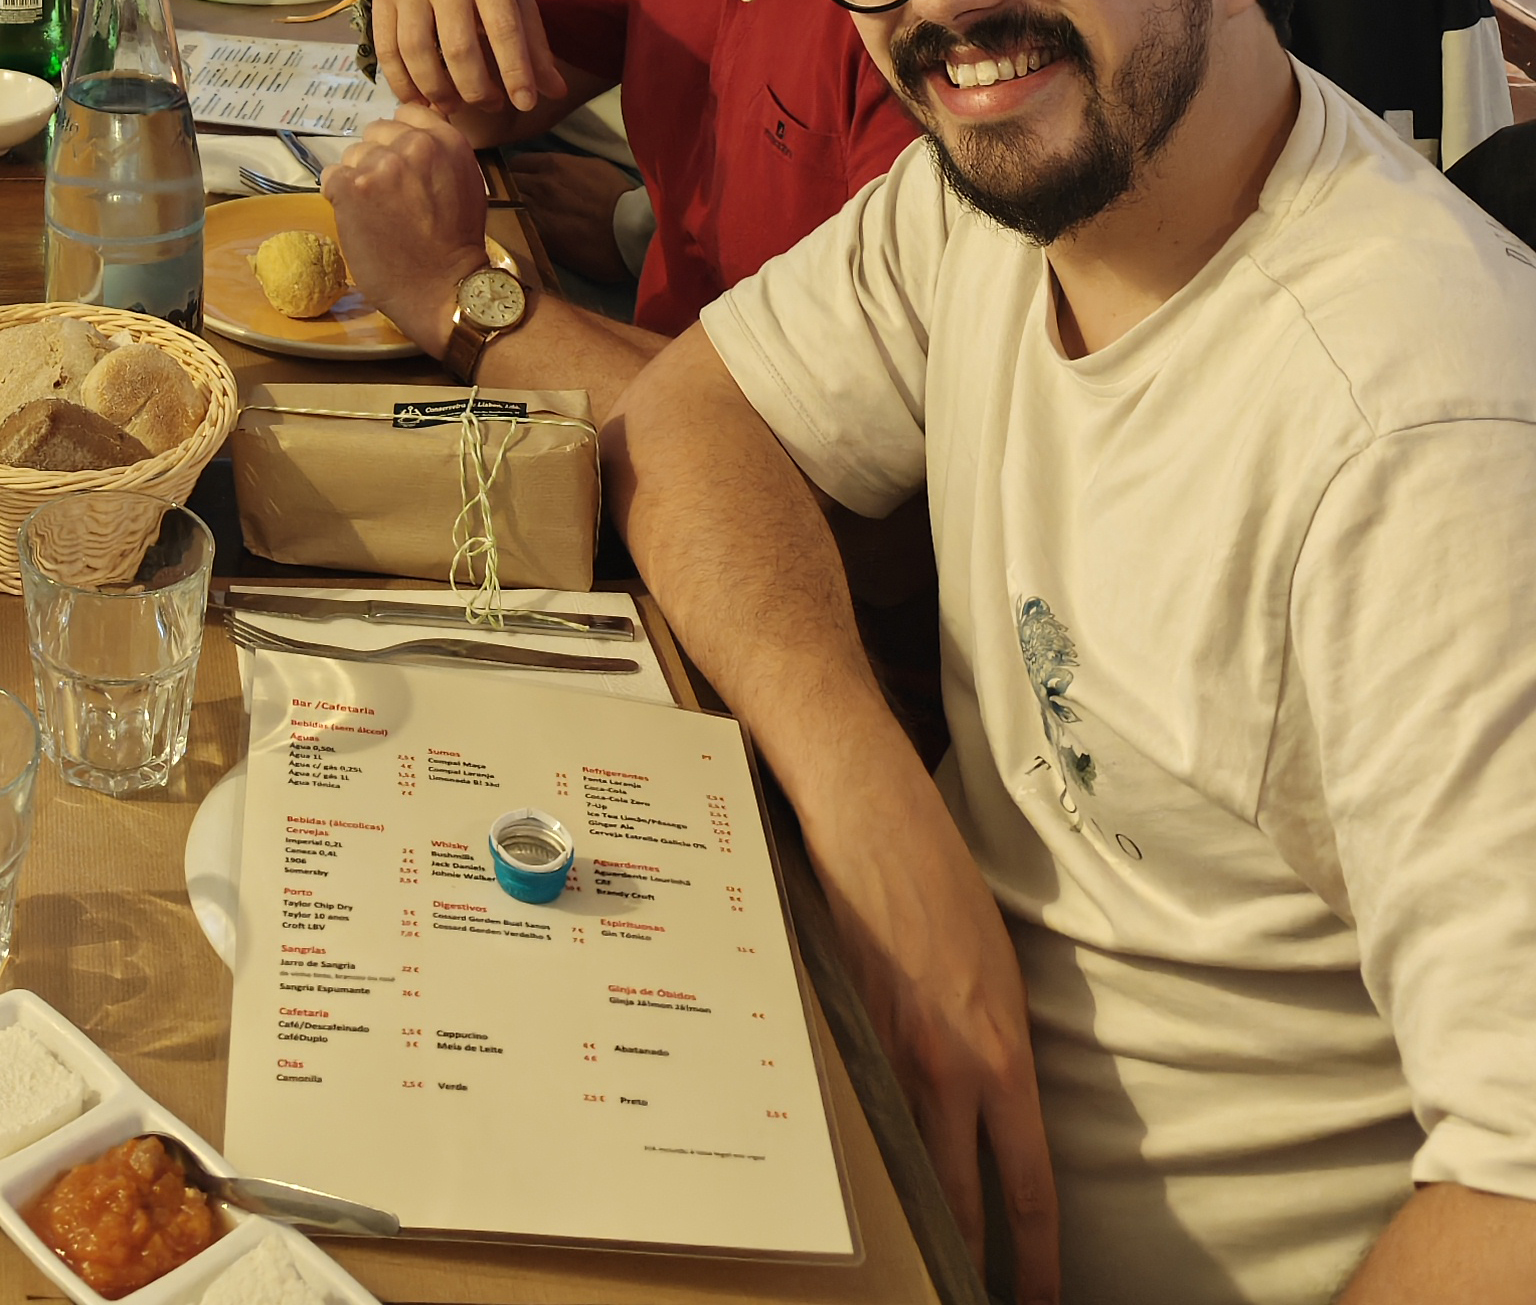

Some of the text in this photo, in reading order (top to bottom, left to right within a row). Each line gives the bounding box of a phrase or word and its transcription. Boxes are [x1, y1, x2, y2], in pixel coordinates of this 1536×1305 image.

[292, 699, 312, 708] Bar
[287, 816, 326, 826] Bebidas
[286, 826, 330, 836] Cervejas
[286, 837, 322, 846] Imperial
[431, 841, 469, 852] Whisky
[431, 851, 474, 861] Bushmills
[453, 862, 485, 872] Daniels
[593, 859, 660, 873] Aguardentes
[284, 867, 329, 877] Somersby
[284, 888, 313, 896] Porto
[283, 900, 353, 912] Taylor Chip Dry
[433, 900, 487, 913] Digestivos
[282, 922, 305, 930] Croft
[600, 919, 666, 932] Espirituosas
[281, 945, 326, 955] Sangrias
[280, 959, 304, 967] Jarro
[321, 961, 356, 970] Sangria
[280, 983, 371, 995] Sangria Espumante
[608, 984, 697, 1001] Ginja de Óbidos
[609, 996, 635, 1007] Ginja
[279, 1007, 329, 1018] Cafetaria
[436, 1030, 488, 1041] Cappucino
[436, 1042, 504, 1055] Meia de Leite
[614, 1044, 670, 1057] Abatanado
[277, 1059, 304, 1069] Chás
[620, 1096, 649, 1107] Preto
